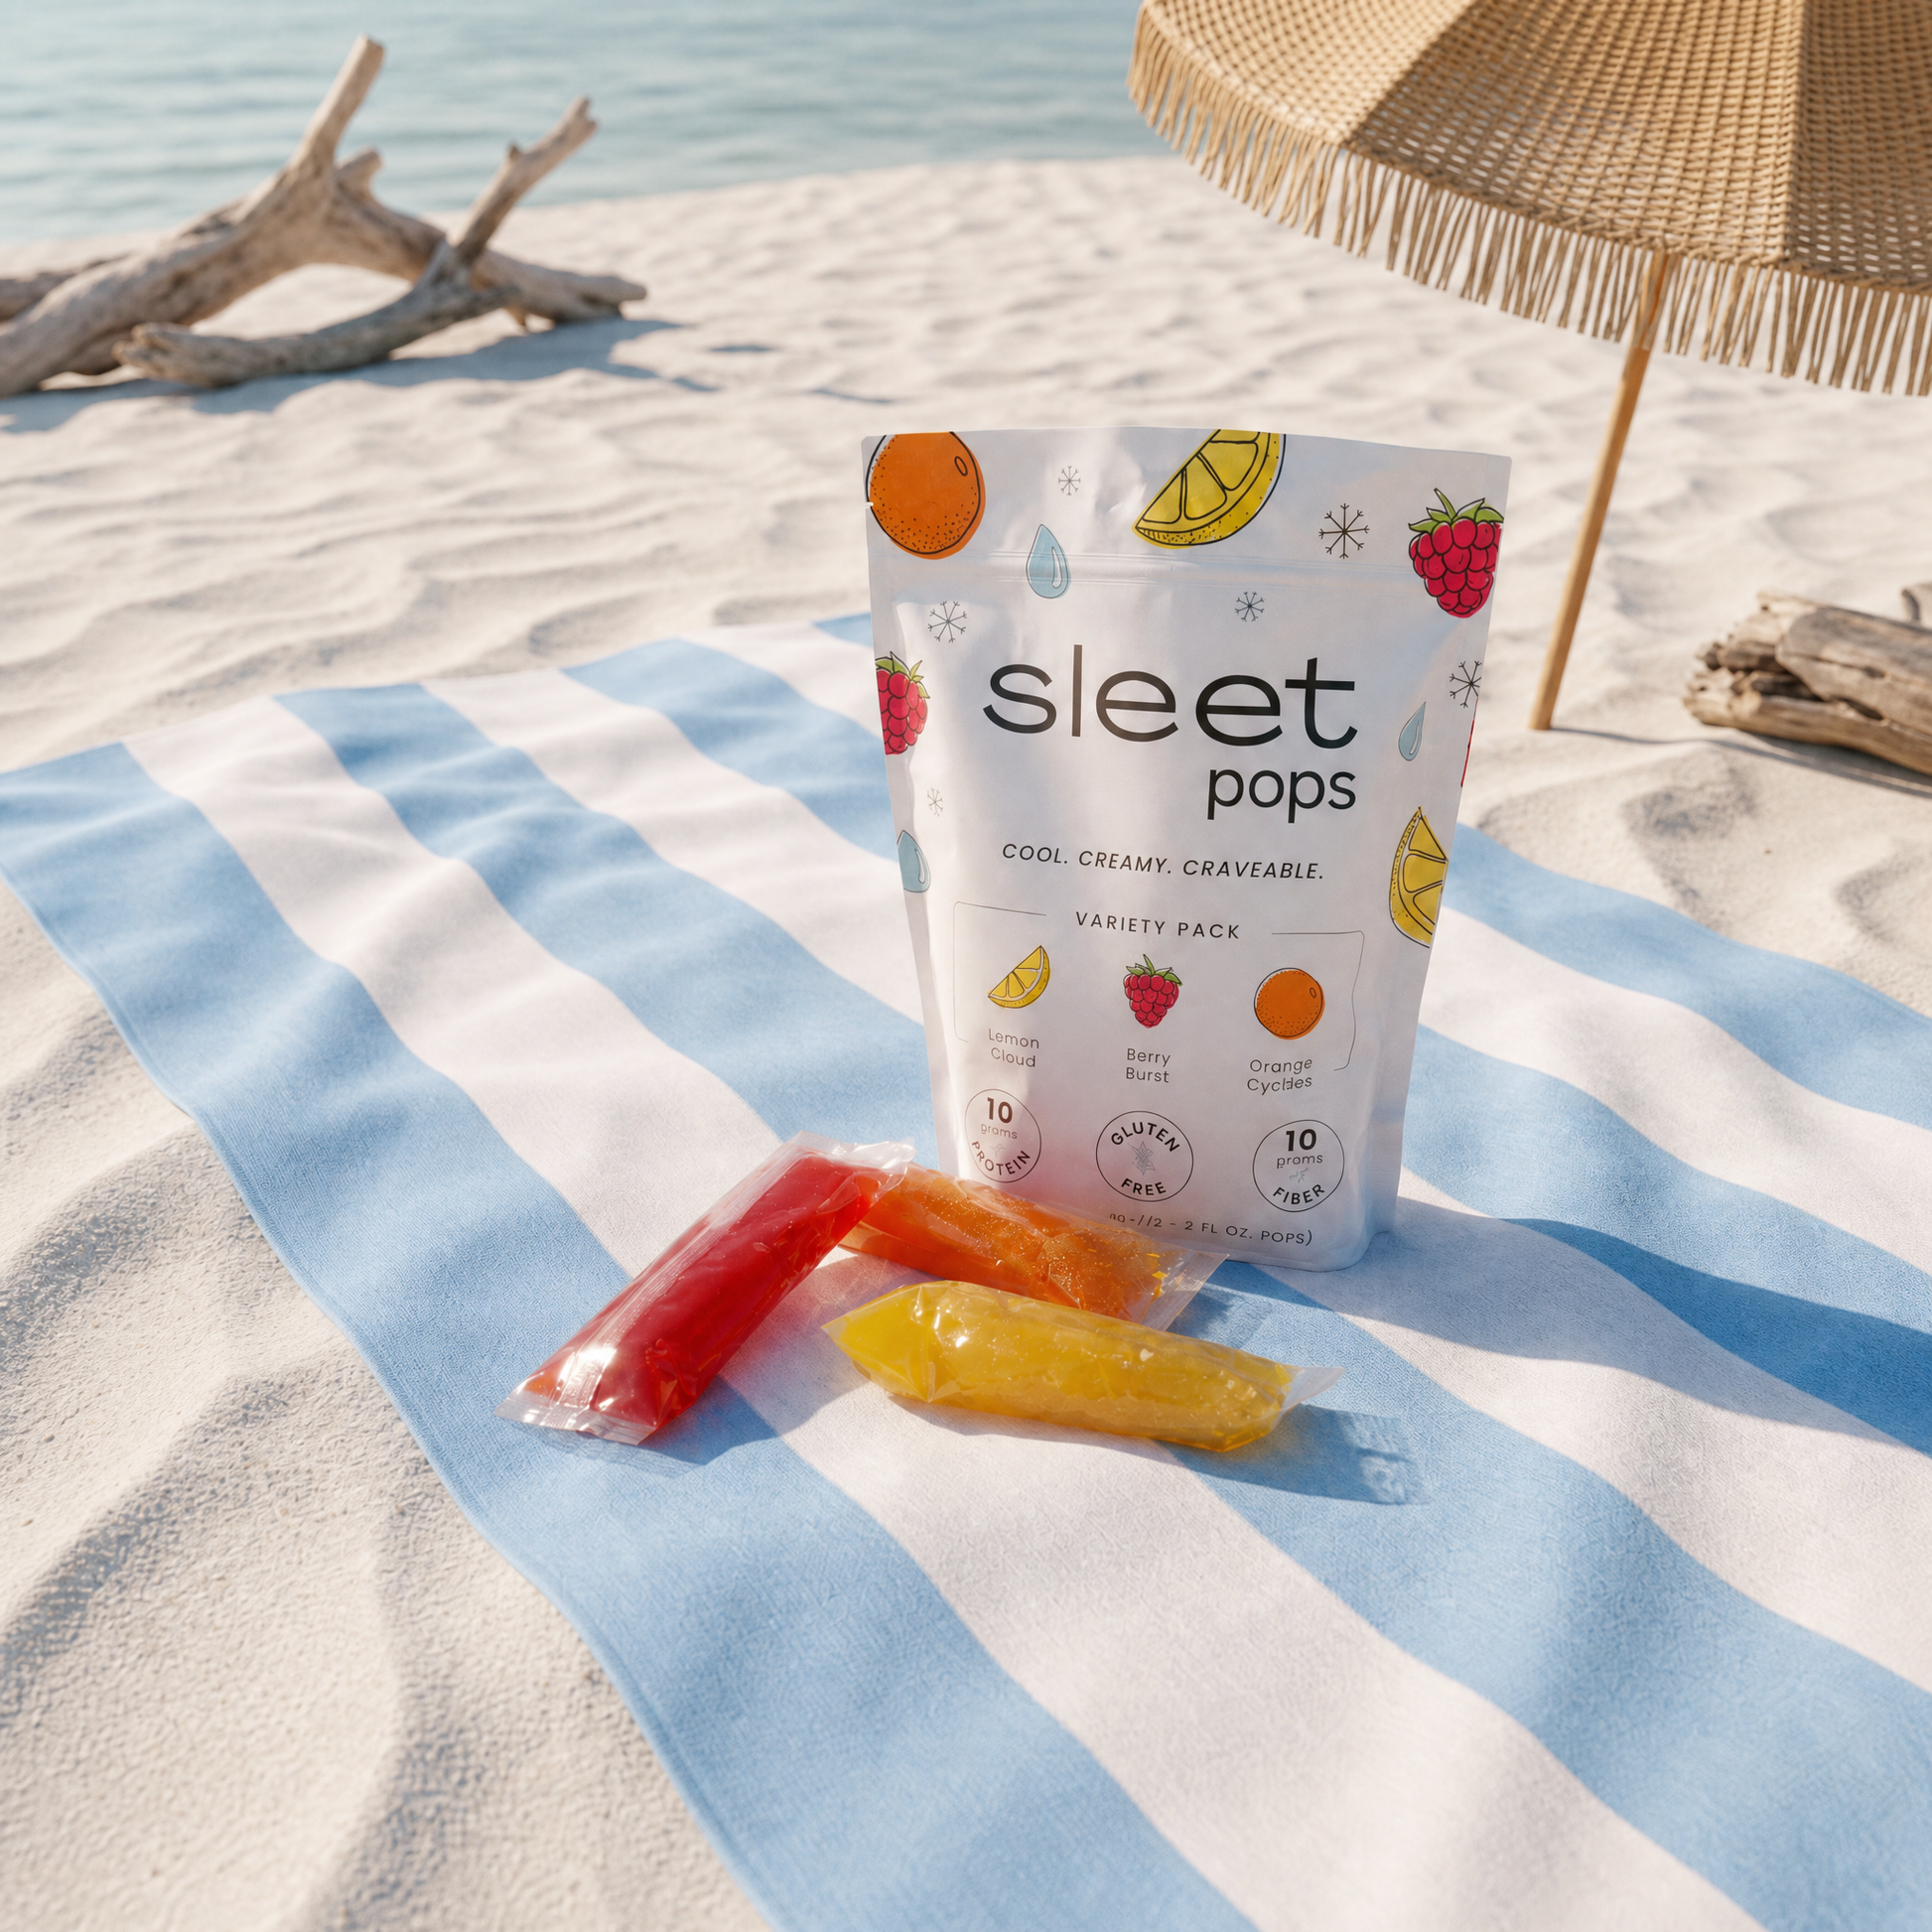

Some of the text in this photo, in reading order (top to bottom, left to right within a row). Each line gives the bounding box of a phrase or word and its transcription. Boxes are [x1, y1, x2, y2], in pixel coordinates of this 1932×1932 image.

[983, 644, 1358, 750] sleet
[1207, 768, 1356, 824] pops
[1002, 843, 1324, 880] COOL. CREAMY. CRAVEABLE.
[1075, 911, 1240, 939] VARIETY PACK
[988, 1028, 1039, 1049] Lemon
[990, 1046, 1035, 1068] Cloud
[1126, 1047, 1172, 1068] Berry
[1250, 1058, 1312, 1075] Orange
[1125, 1066, 1170, 1084] Burst
[987, 1096, 1013, 1124] 10
[1111, 1121, 1180, 1153] GLUTEN
[1285, 1128, 1317, 1152] 10
[971, 1141, 1031, 1176] PROTEIN
[1121, 1177, 1167, 1196] FREE
[1273, 1183, 1325, 1205] FIBER
[1184, 1220, 1193, 1231] 2
[1201, 1222, 1218, 1234] FL
[1225, 1225, 1253, 1240] OZ.
[1260, 1229, 1313, 1247] POPS)
